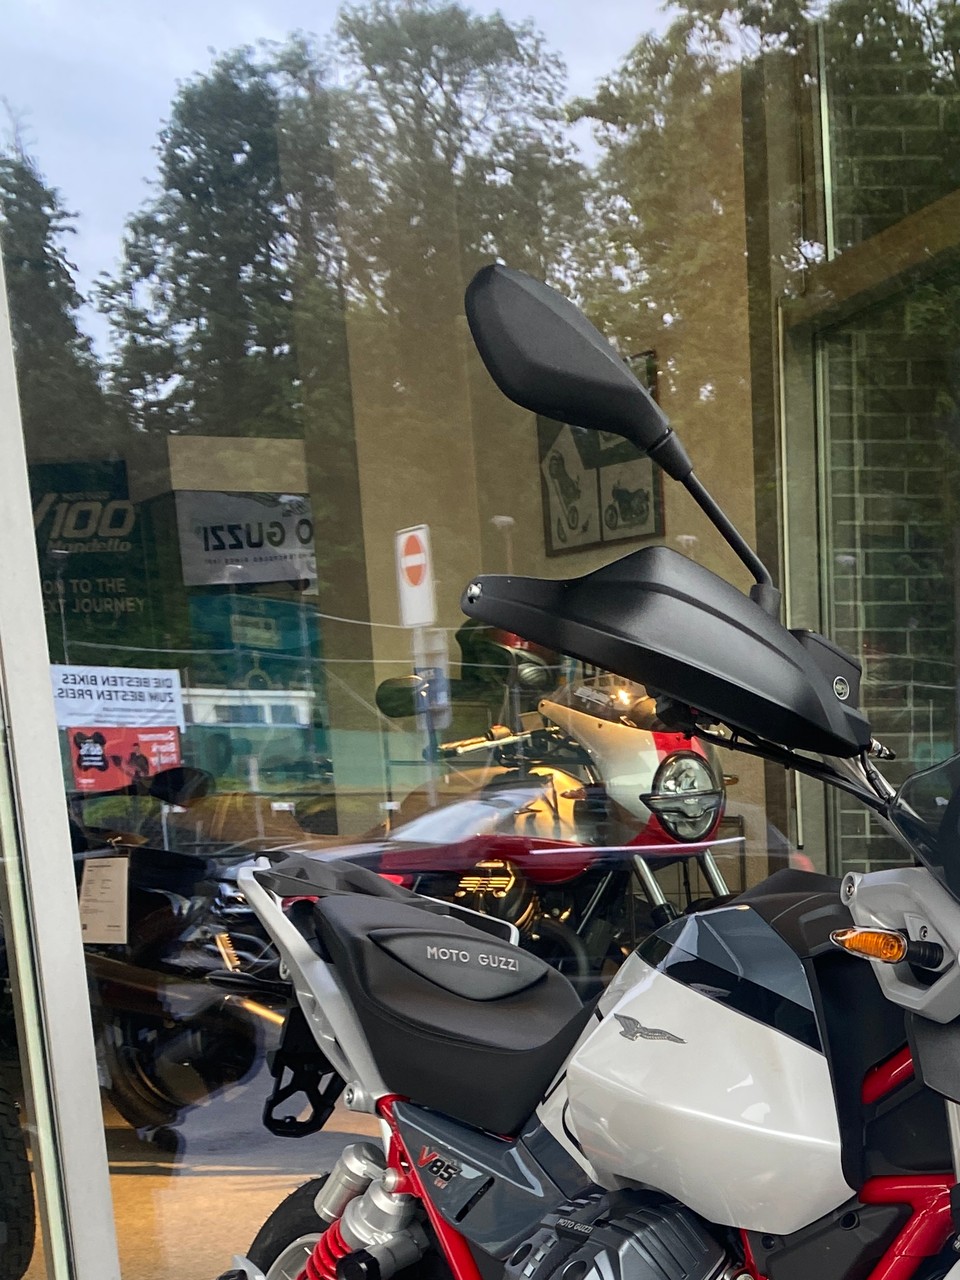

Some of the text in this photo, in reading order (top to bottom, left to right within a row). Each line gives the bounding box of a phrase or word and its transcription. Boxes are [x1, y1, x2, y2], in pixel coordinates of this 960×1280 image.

[70, 579, 92, 593] TO
[95, 578, 127, 593] THE
[72, 597, 145, 613] JOURNEY
[426, 945, 519, 972] MOTO GUZZI
[417, 1145, 460, 1182] V85
[573, 1223, 594, 1234] GUZZI
